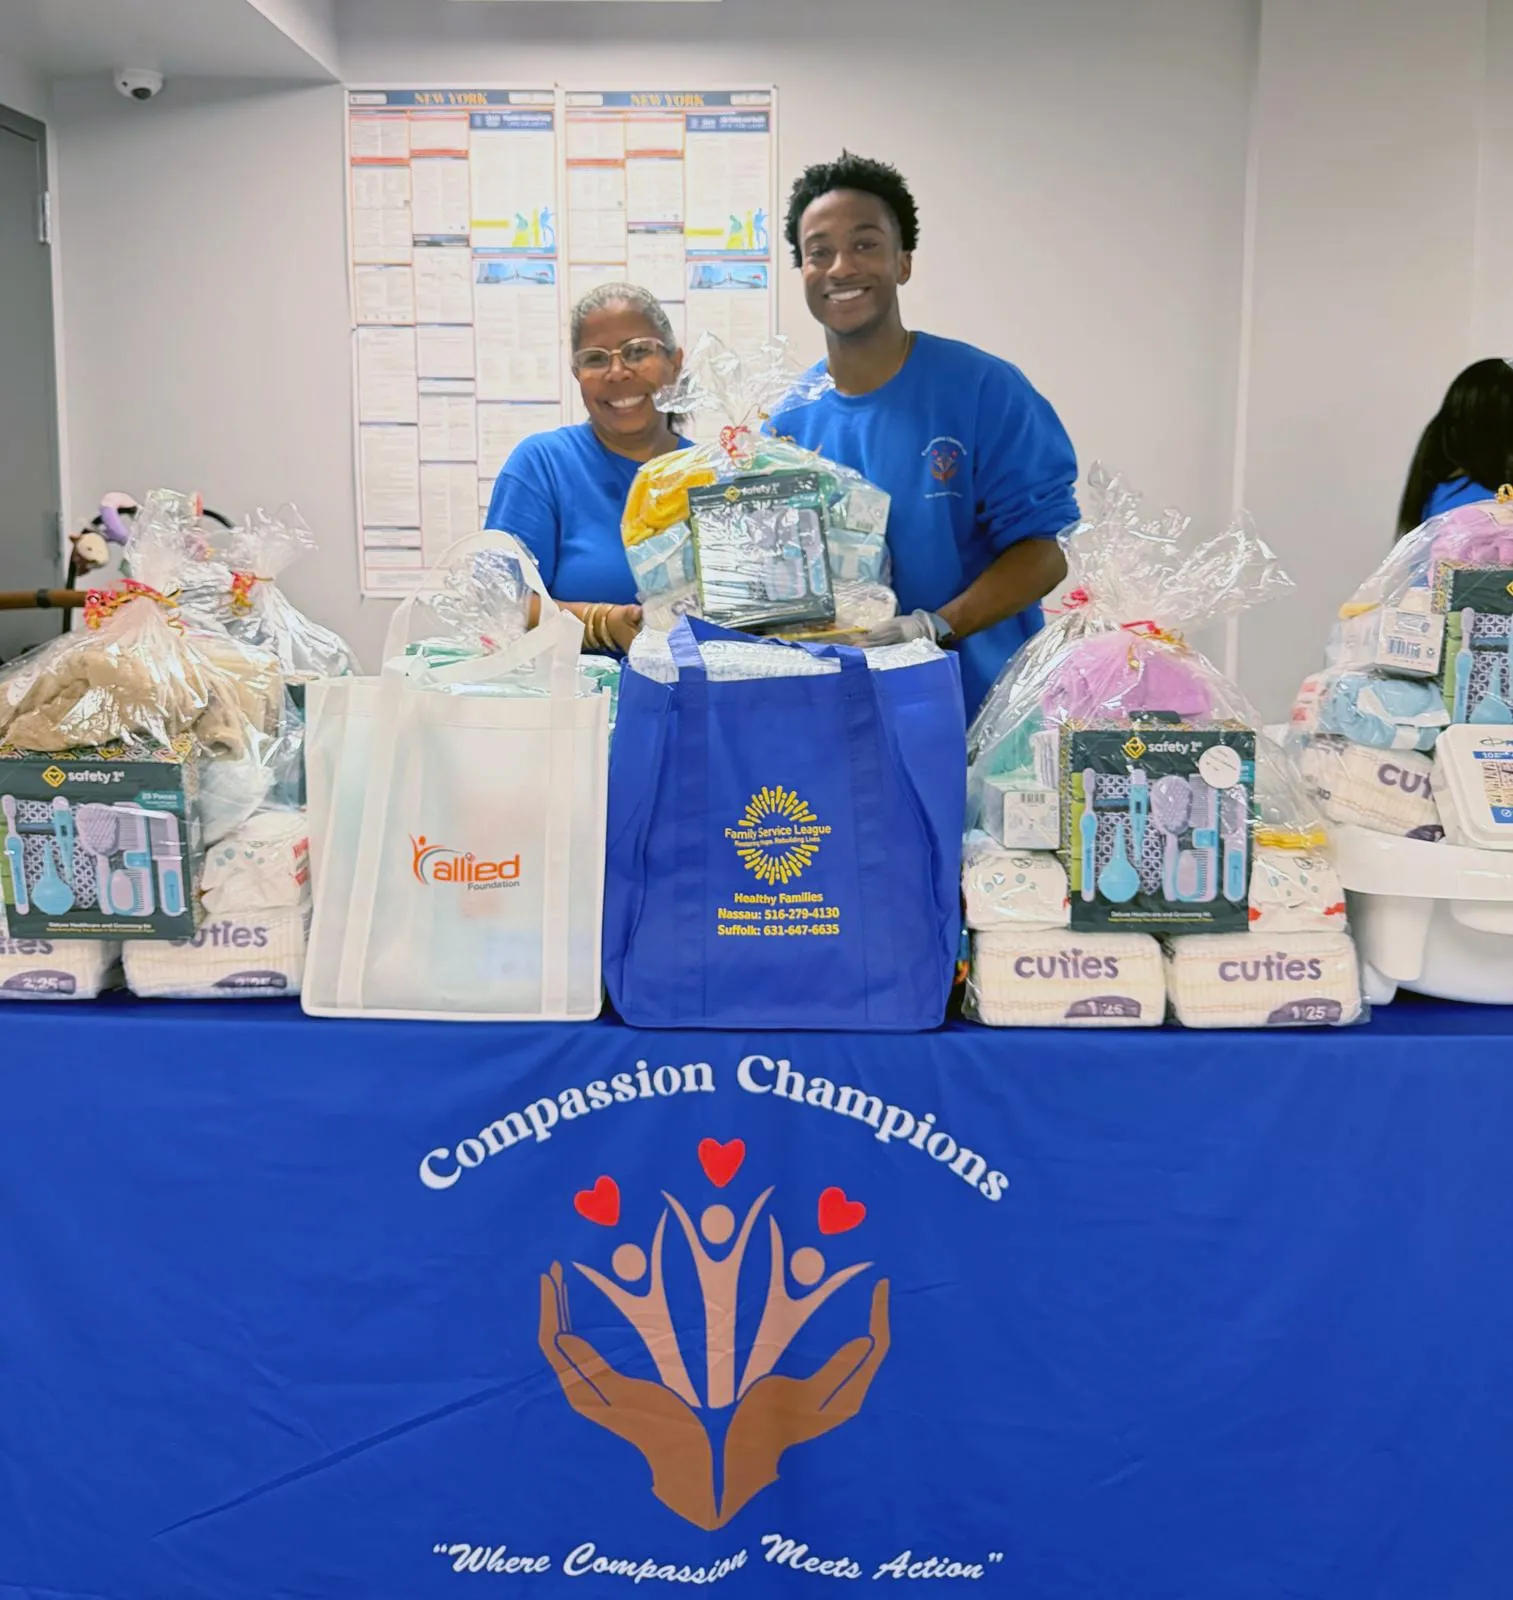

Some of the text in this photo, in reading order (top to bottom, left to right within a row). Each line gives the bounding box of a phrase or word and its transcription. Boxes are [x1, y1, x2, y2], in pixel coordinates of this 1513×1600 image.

[414, 91, 488, 105] NEW YORK
[630, 93, 705, 107] NEW YORK
[1147, 741, 1189, 755] safety
[67, 769, 111, 784] safety
[724, 824, 832, 840] Family Service League
[433, 852, 520, 881] allied
[467, 881, 520, 891] Foundation
[734, 892, 824, 906] Healthy Families
[717, 906, 840, 920] Nassau: 516-279-4130
[717, 923, 840, 937] Suffolk: 631-647-6635
[1014, 947, 1120, 979] cuties
[1218, 951, 1323, 982] cuties
[419, 1054, 1010, 1202] Compassion Champions
[432, 1542, 552, 1575] “Where
[563, 1541, 748, 1586] Compassion
[761, 1533, 863, 1580] Meets
